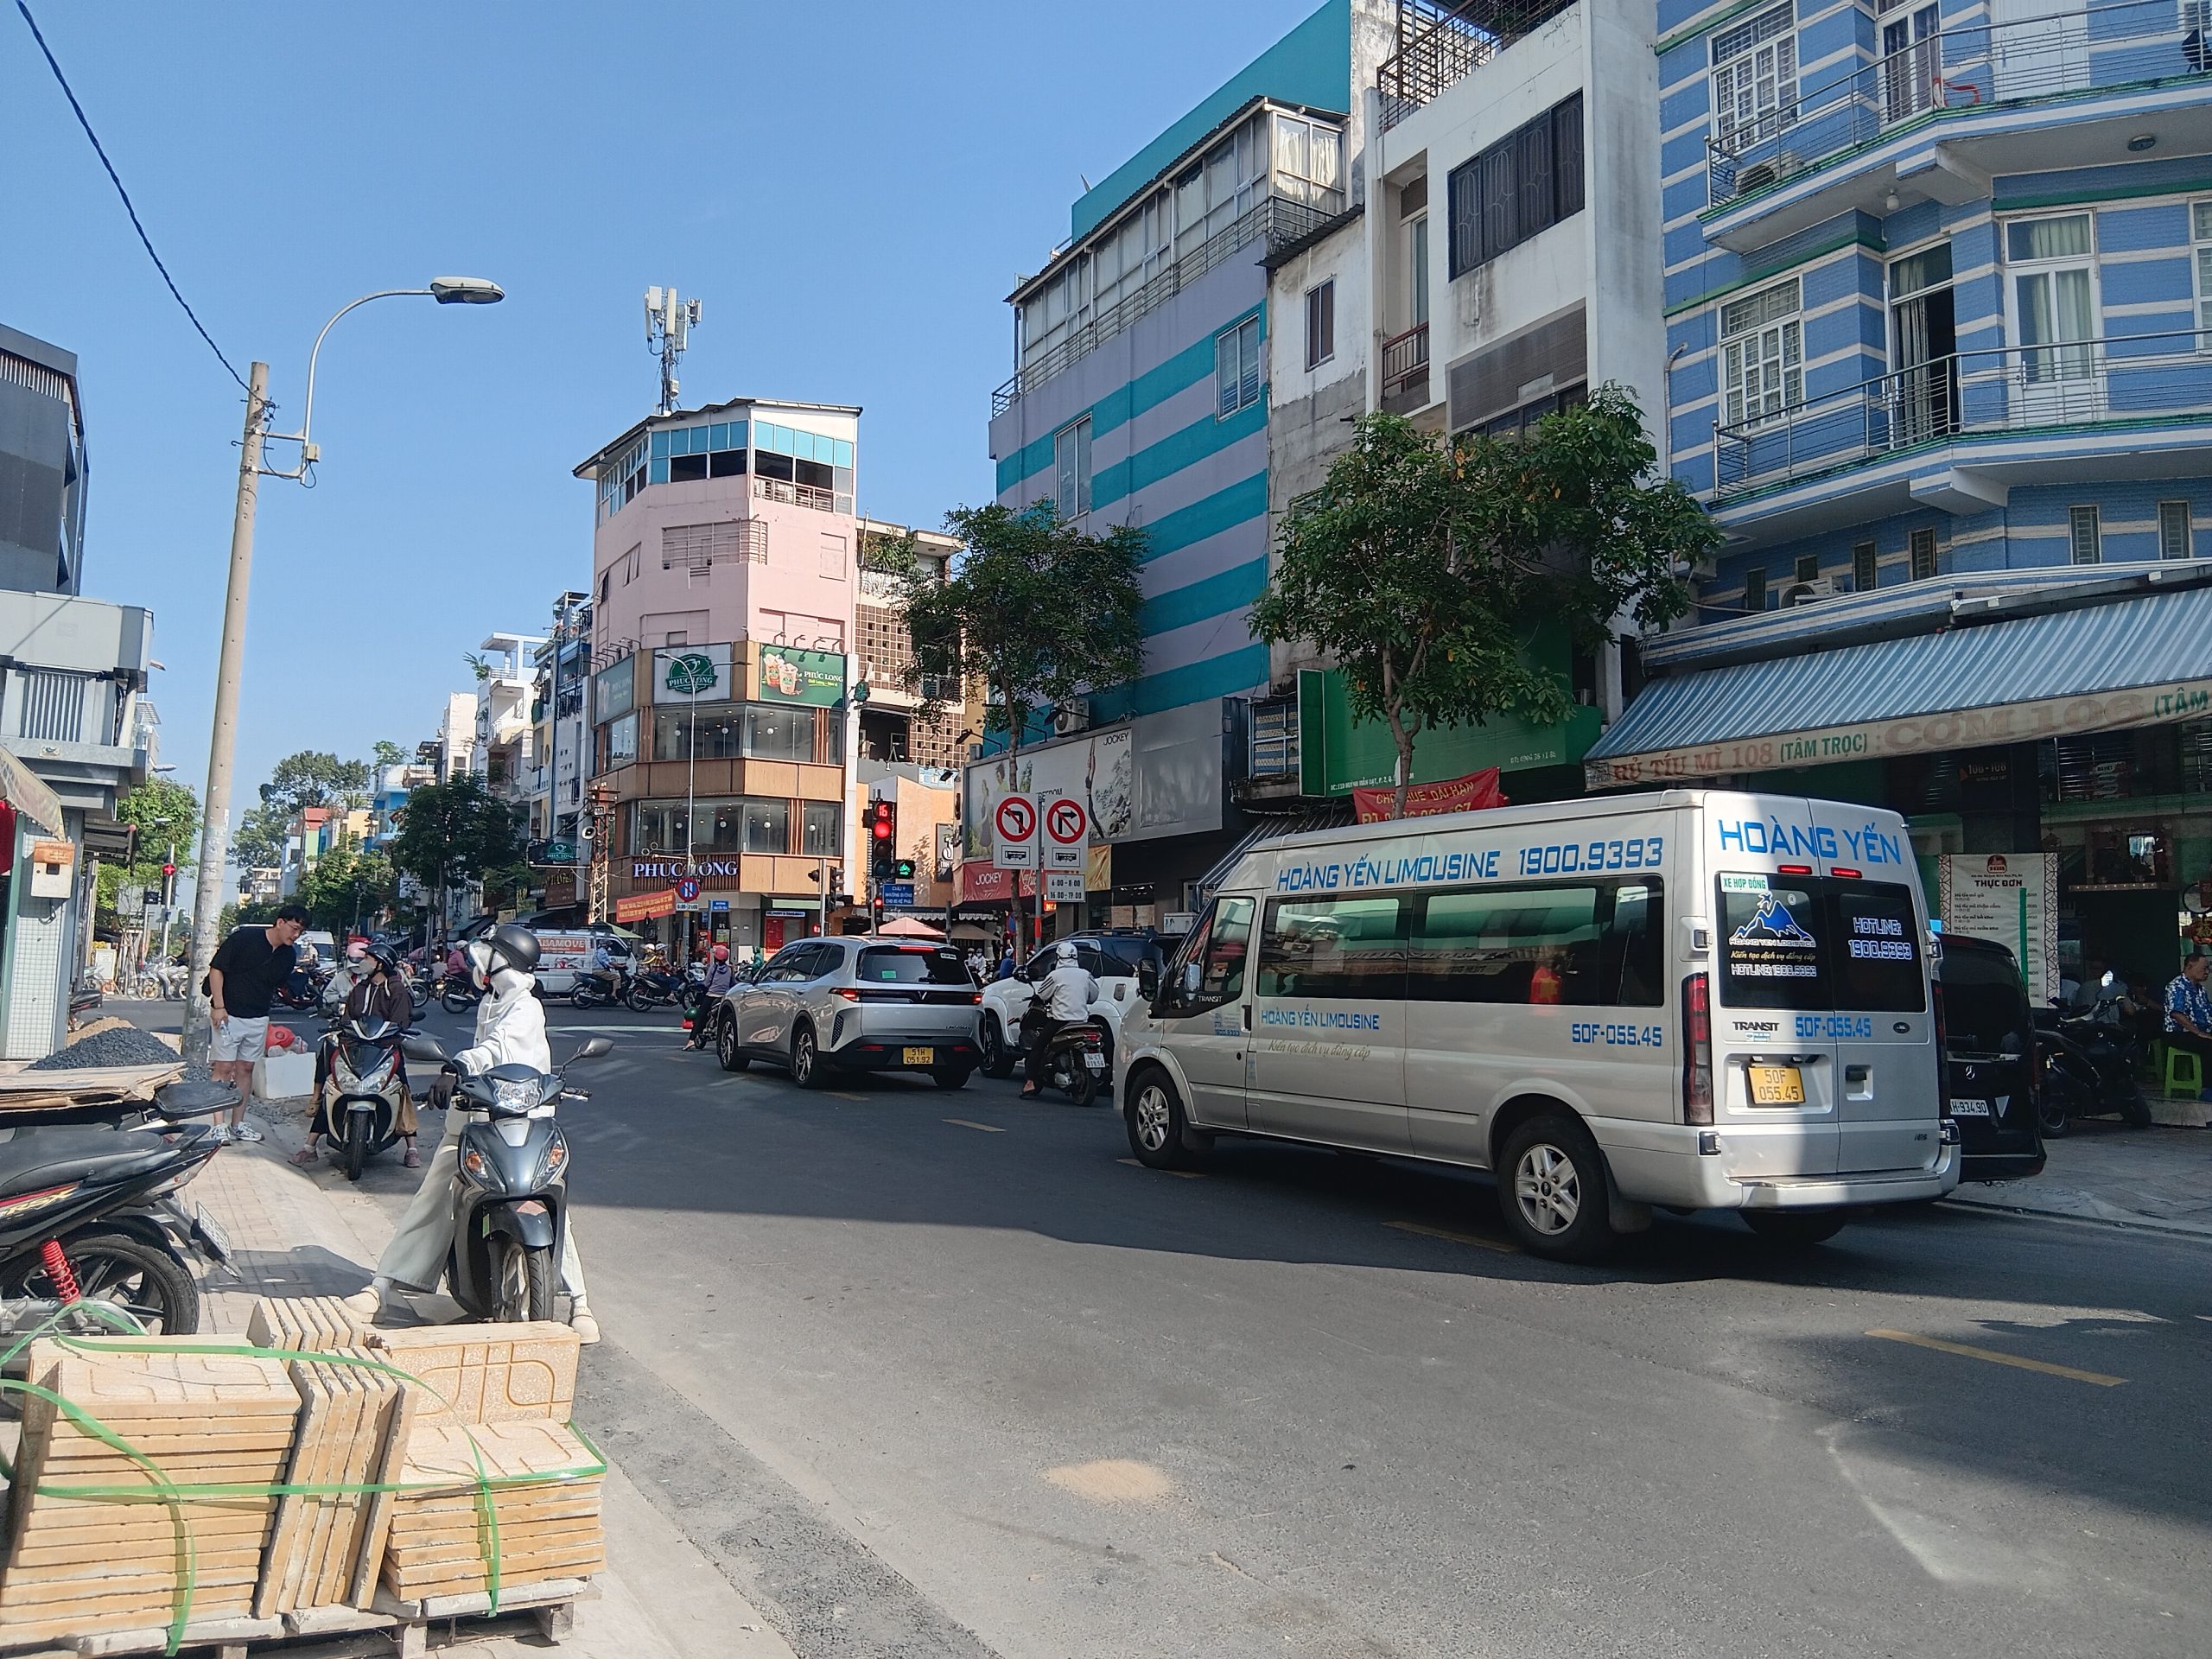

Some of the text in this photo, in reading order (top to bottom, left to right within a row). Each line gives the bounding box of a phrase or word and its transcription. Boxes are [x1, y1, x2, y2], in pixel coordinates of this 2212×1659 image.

[1103, 732, 1129, 746] JOCKEY
[1732, 742, 1773, 768] 108
[879, 804, 887, 817] 16
[1718, 815, 1901, 864] HOÀNG YẾN
[1277, 836, 1663, 892] HOÀNG YẾN LIMOUSINE 1900.9393
[975, 871, 1003, 886] JOCKEY
[1723, 877, 1732, 887] XE
[1974, 880, 2000, 888] THỰC
[1853, 918, 1903, 936] HOTLINE:
[1848, 939, 1912, 960] 1900.9393
[1262, 1007, 1296, 1026] HOÀNG
[1298, 1004, 1318, 1026] YẾN
[1320, 1012, 1380, 1030] LIMOUSINE
[1572, 1023, 1662, 1047] 50F-055.45
[1732, 1016, 1872, 1038] TRANSIT 50F-055.45
[1764, 1069, 1786, 1084] 50F
[1759, 1085, 1800, 1101] 055.45
